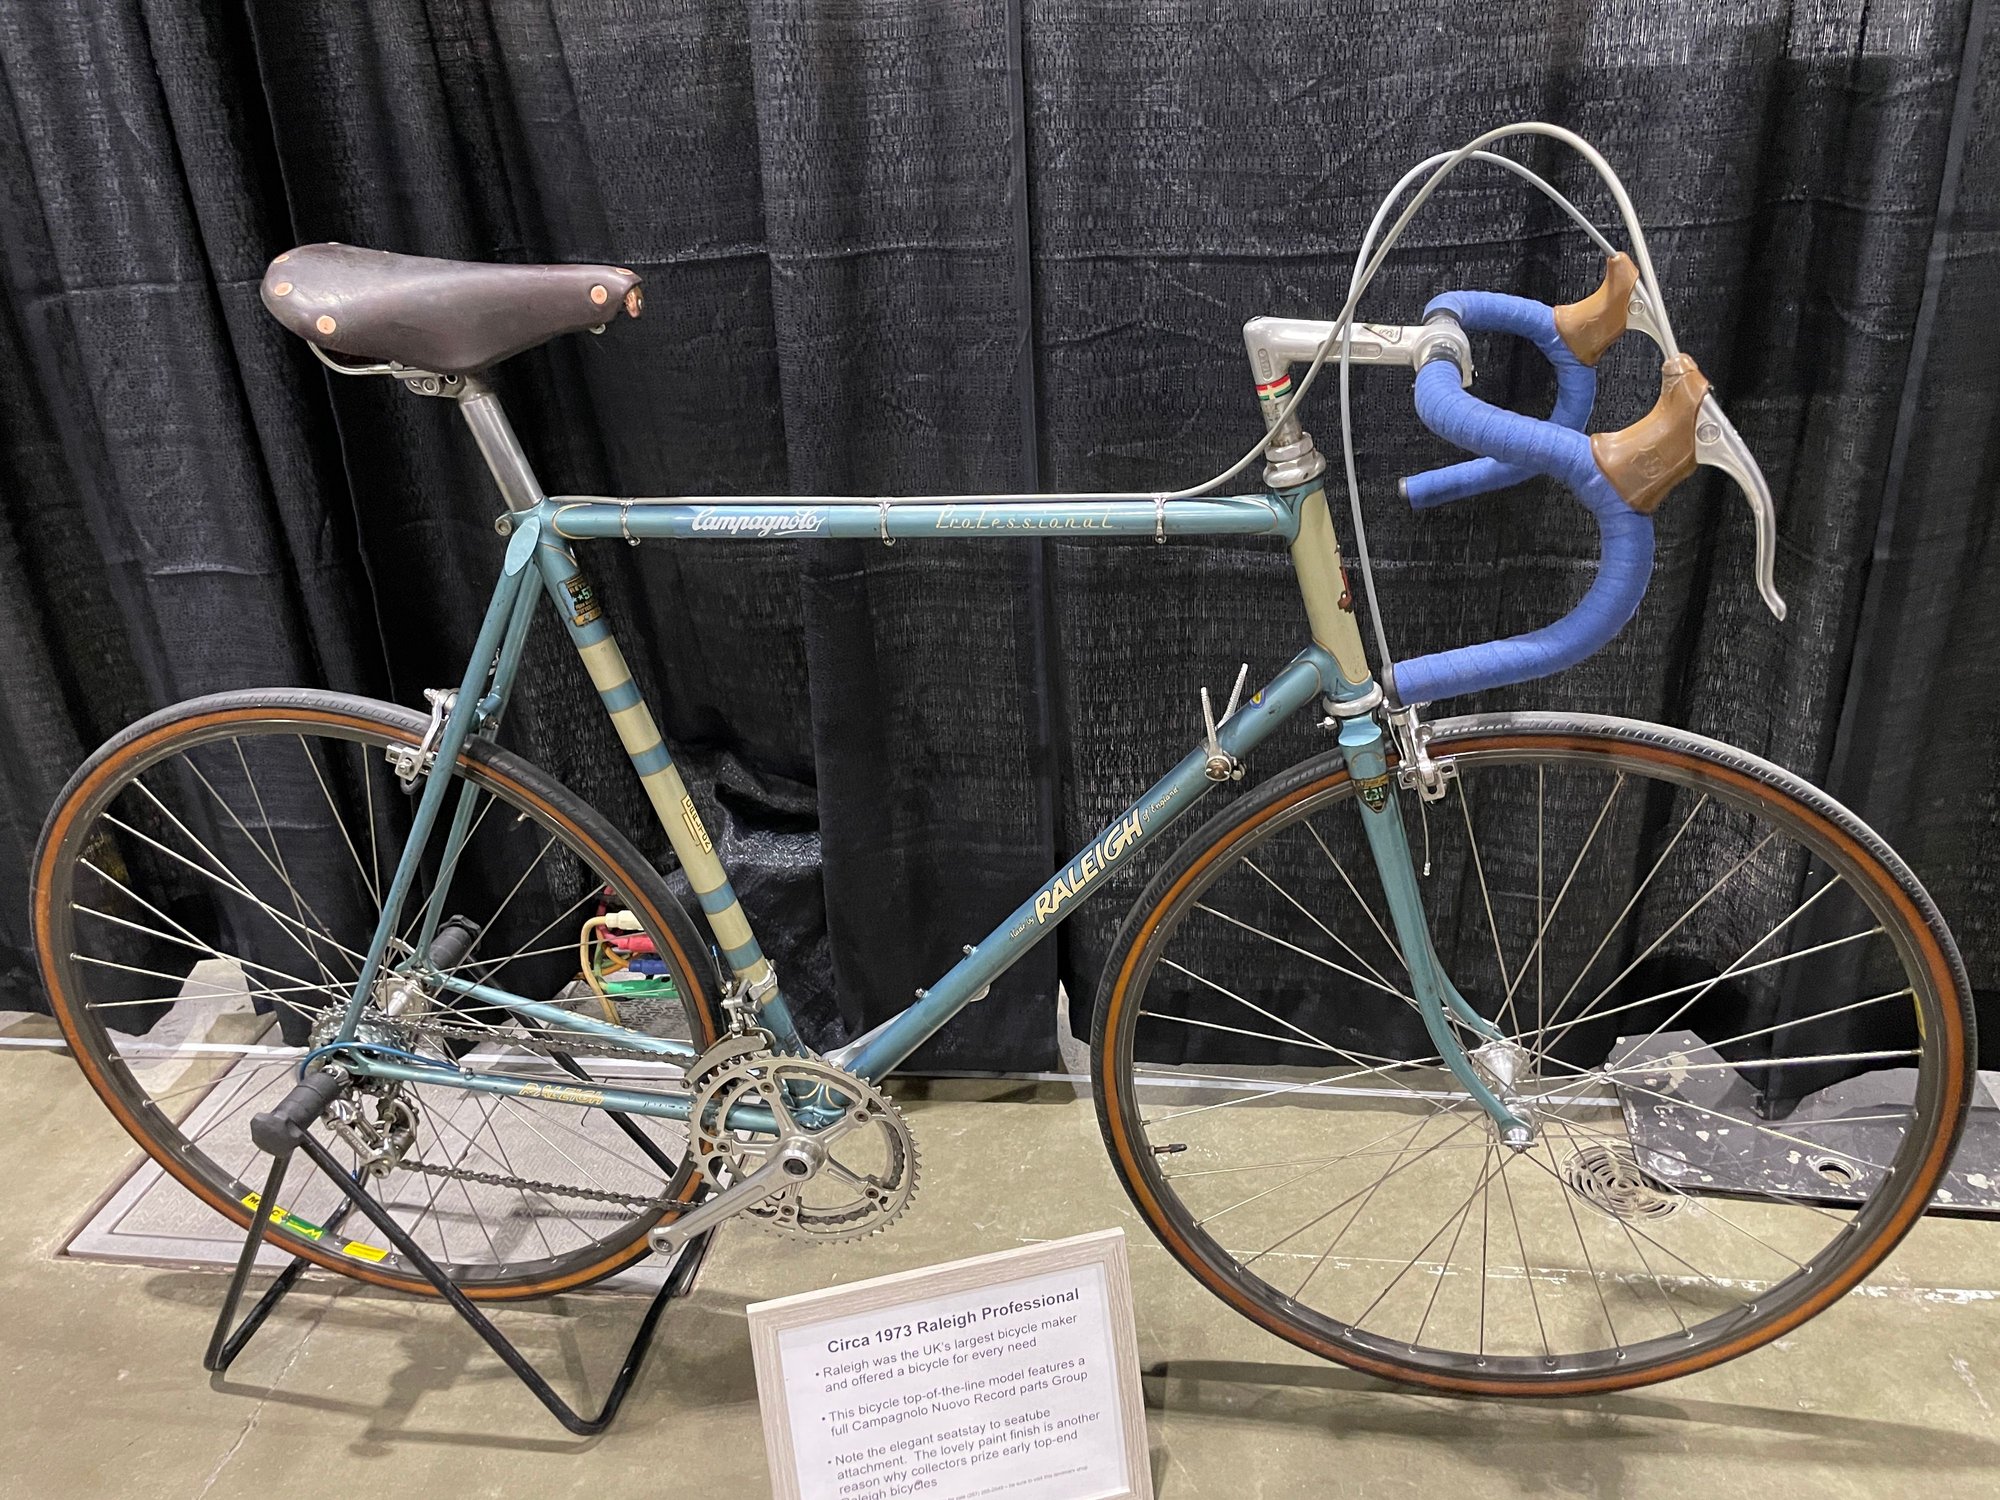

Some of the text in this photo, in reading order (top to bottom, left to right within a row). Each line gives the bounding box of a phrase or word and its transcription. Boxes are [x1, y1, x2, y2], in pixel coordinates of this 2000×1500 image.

[692, 507, 826, 537] Campagnolo
[936, 504, 1113, 529] Professional
[1034, 807, 1143, 925] RALEIGH
[823, 1314, 1077, 1378] Raleigh was the UK's largest bicycle maker
[827, 1287, 1079, 1353] Circa 1973 Raleigh Professional
[825, 1337, 1037, 1393] and offered a bicycle for every need
[829, 1357, 1085, 1422] This bicycle top-of-the-line model features a
[831, 1371, 1088, 1437] full Campagnolo Nuovo Record parts Group
[835, 1408, 1051, 1466] Note the elegant seatstay to seatube
[837, 1412, 1100, 1480] attachment. The lovely paint finish is another
[839, 1430, 1078, 1495] reason why collectors prize early top-end
[890, 1478, 938, 1496] bicycles
